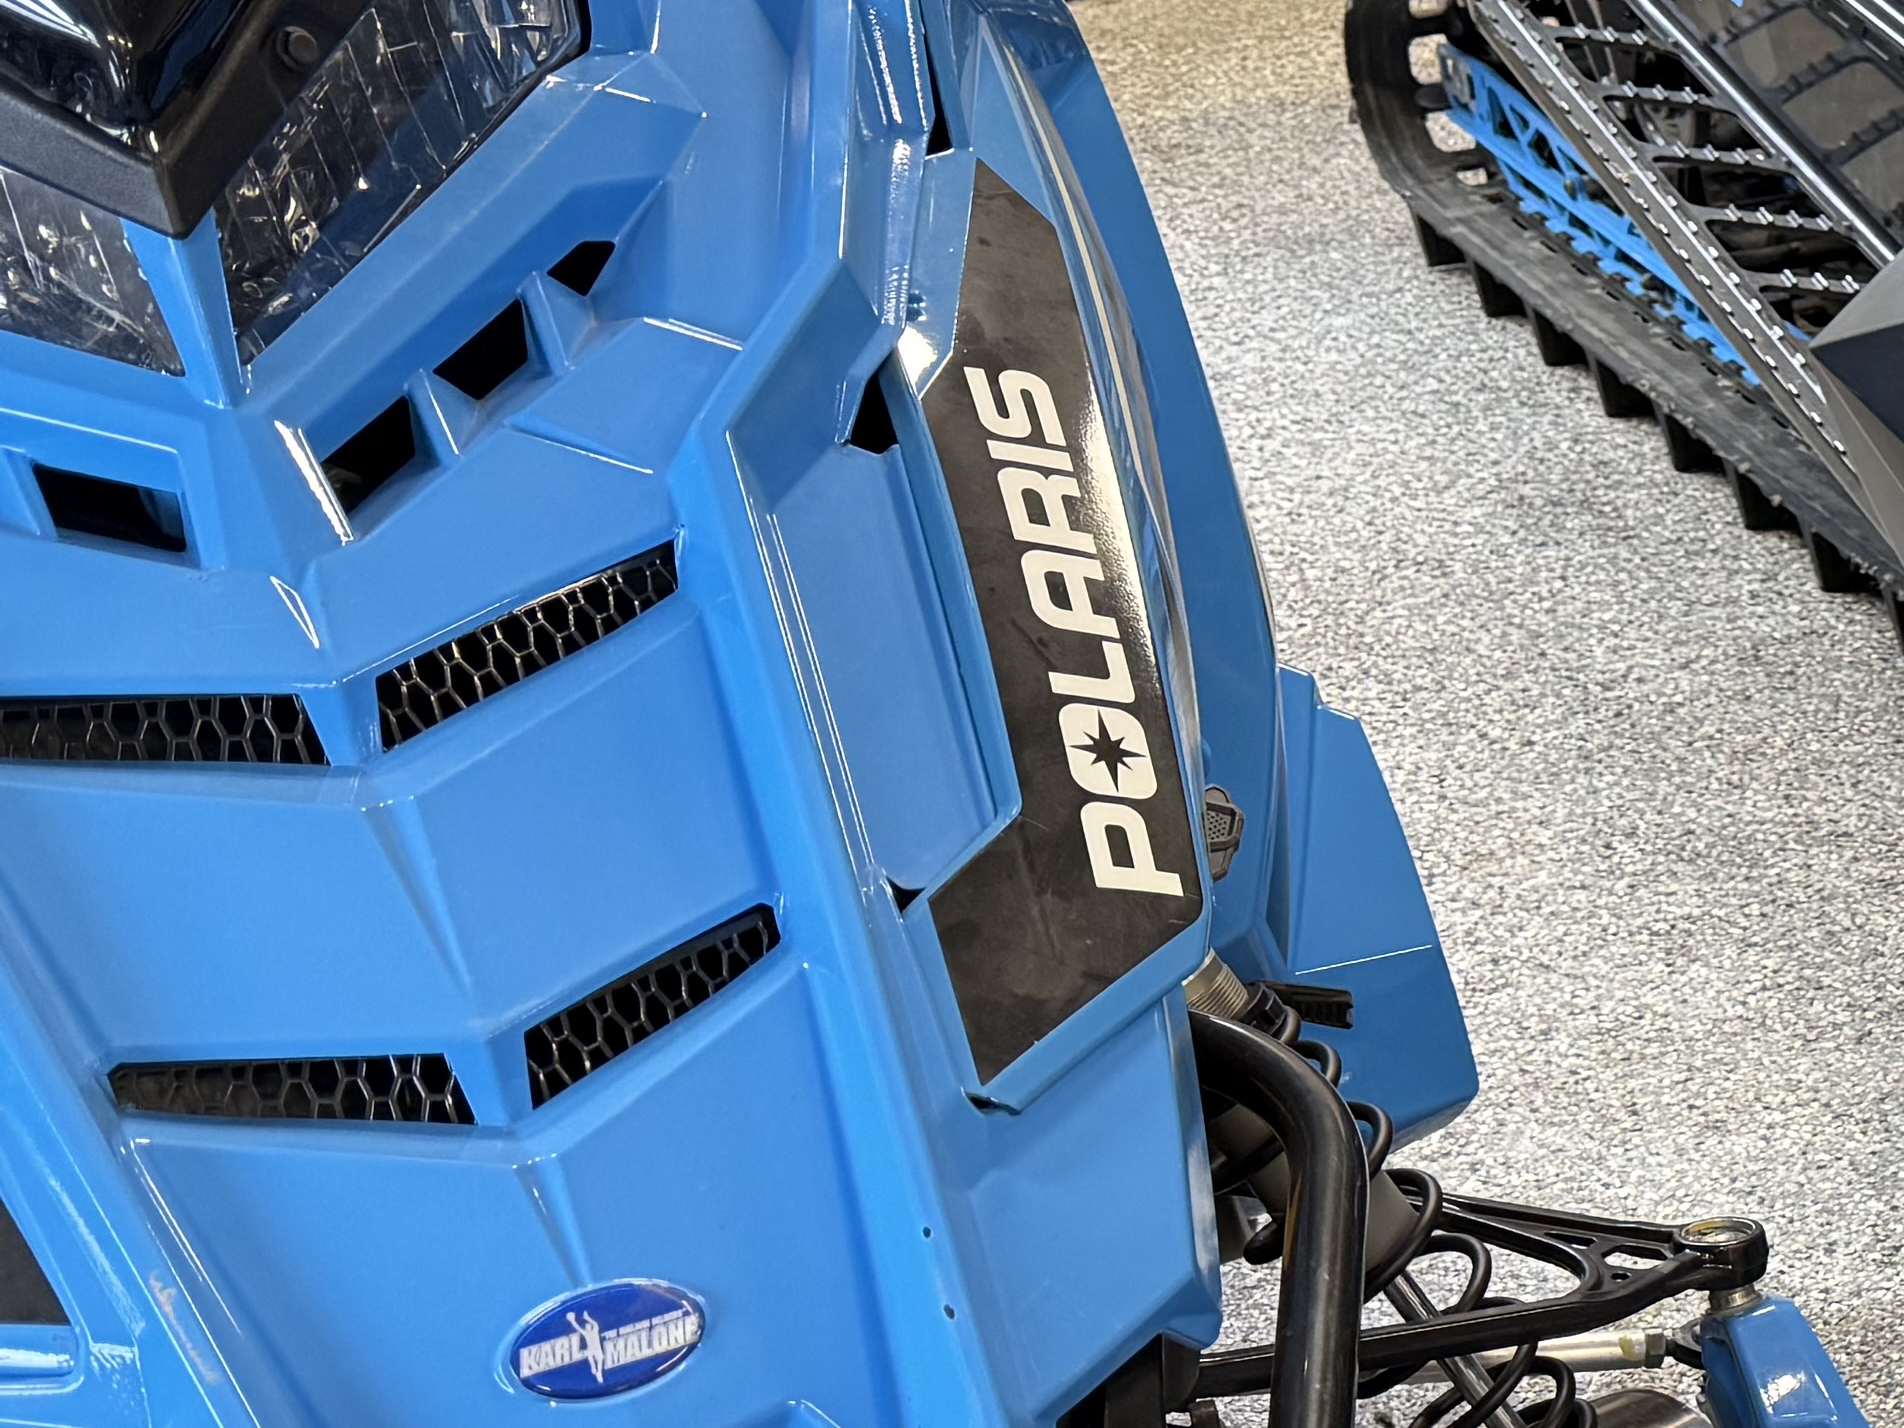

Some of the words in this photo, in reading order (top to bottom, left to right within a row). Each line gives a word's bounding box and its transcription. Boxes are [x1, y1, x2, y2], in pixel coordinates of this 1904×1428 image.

[963, 365, 1185, 898] POLARIS
[519, 1329, 589, 1379] KARL
[602, 1312, 702, 1371] MALONE
